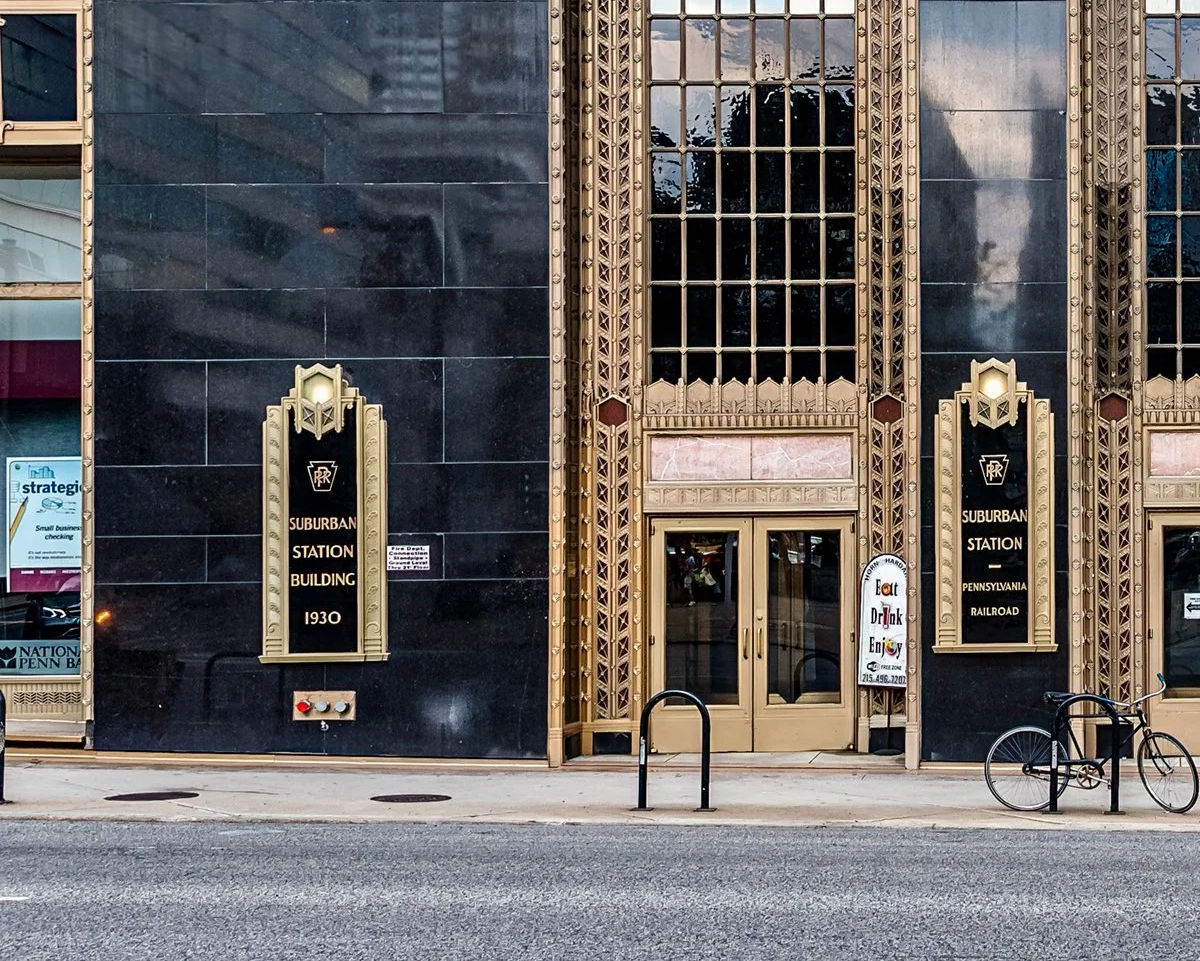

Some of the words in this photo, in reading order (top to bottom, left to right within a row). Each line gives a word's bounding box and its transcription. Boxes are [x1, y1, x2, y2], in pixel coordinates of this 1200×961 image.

[22, 480, 81, 496] strategi
[289, 516, 357, 531] SUBURBAN
[962, 508, 1028, 524] SUBURBAN
[967, 536, 1023, 551] STATION
[292, 544, 354, 559] STATION
[864, 560, 879, 581] HORN
[290, 572, 356, 587] BUILDING
[962, 581, 1028, 593] PENNSYLVANIA
[875, 578, 899, 597] Eat
[304, 611, 342, 625] 1930
[970, 606, 1020, 617] RAILROAD
[19, 645, 81, 658] NATION
[869, 636, 903, 659] Enjoy
[19, 657, 61, 669] PENN
